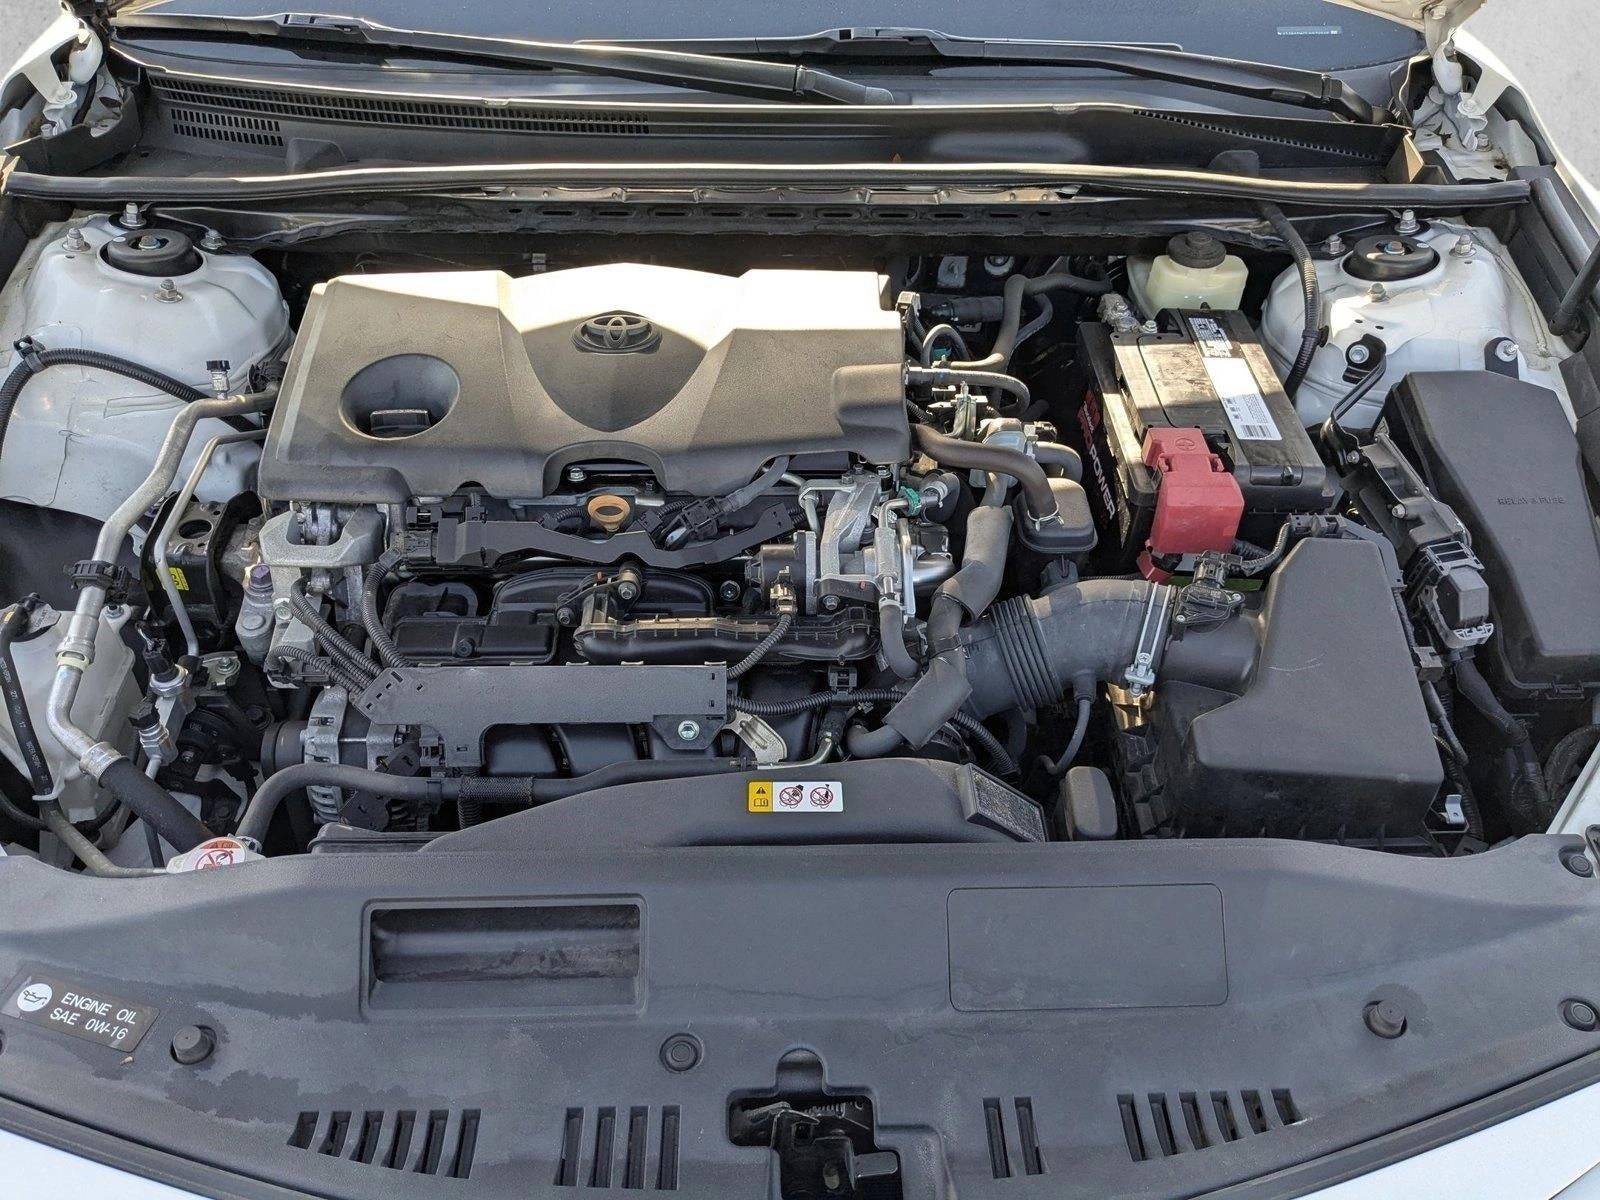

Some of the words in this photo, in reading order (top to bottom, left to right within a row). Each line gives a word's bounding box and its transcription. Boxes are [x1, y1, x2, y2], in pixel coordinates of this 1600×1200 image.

[50, 1007, 81, 1026] SAE
[85, 1018, 129, 1040] 0W-16
[61, 992, 113, 1016] ENGINE
[116, 1008, 138, 1025] OIL
